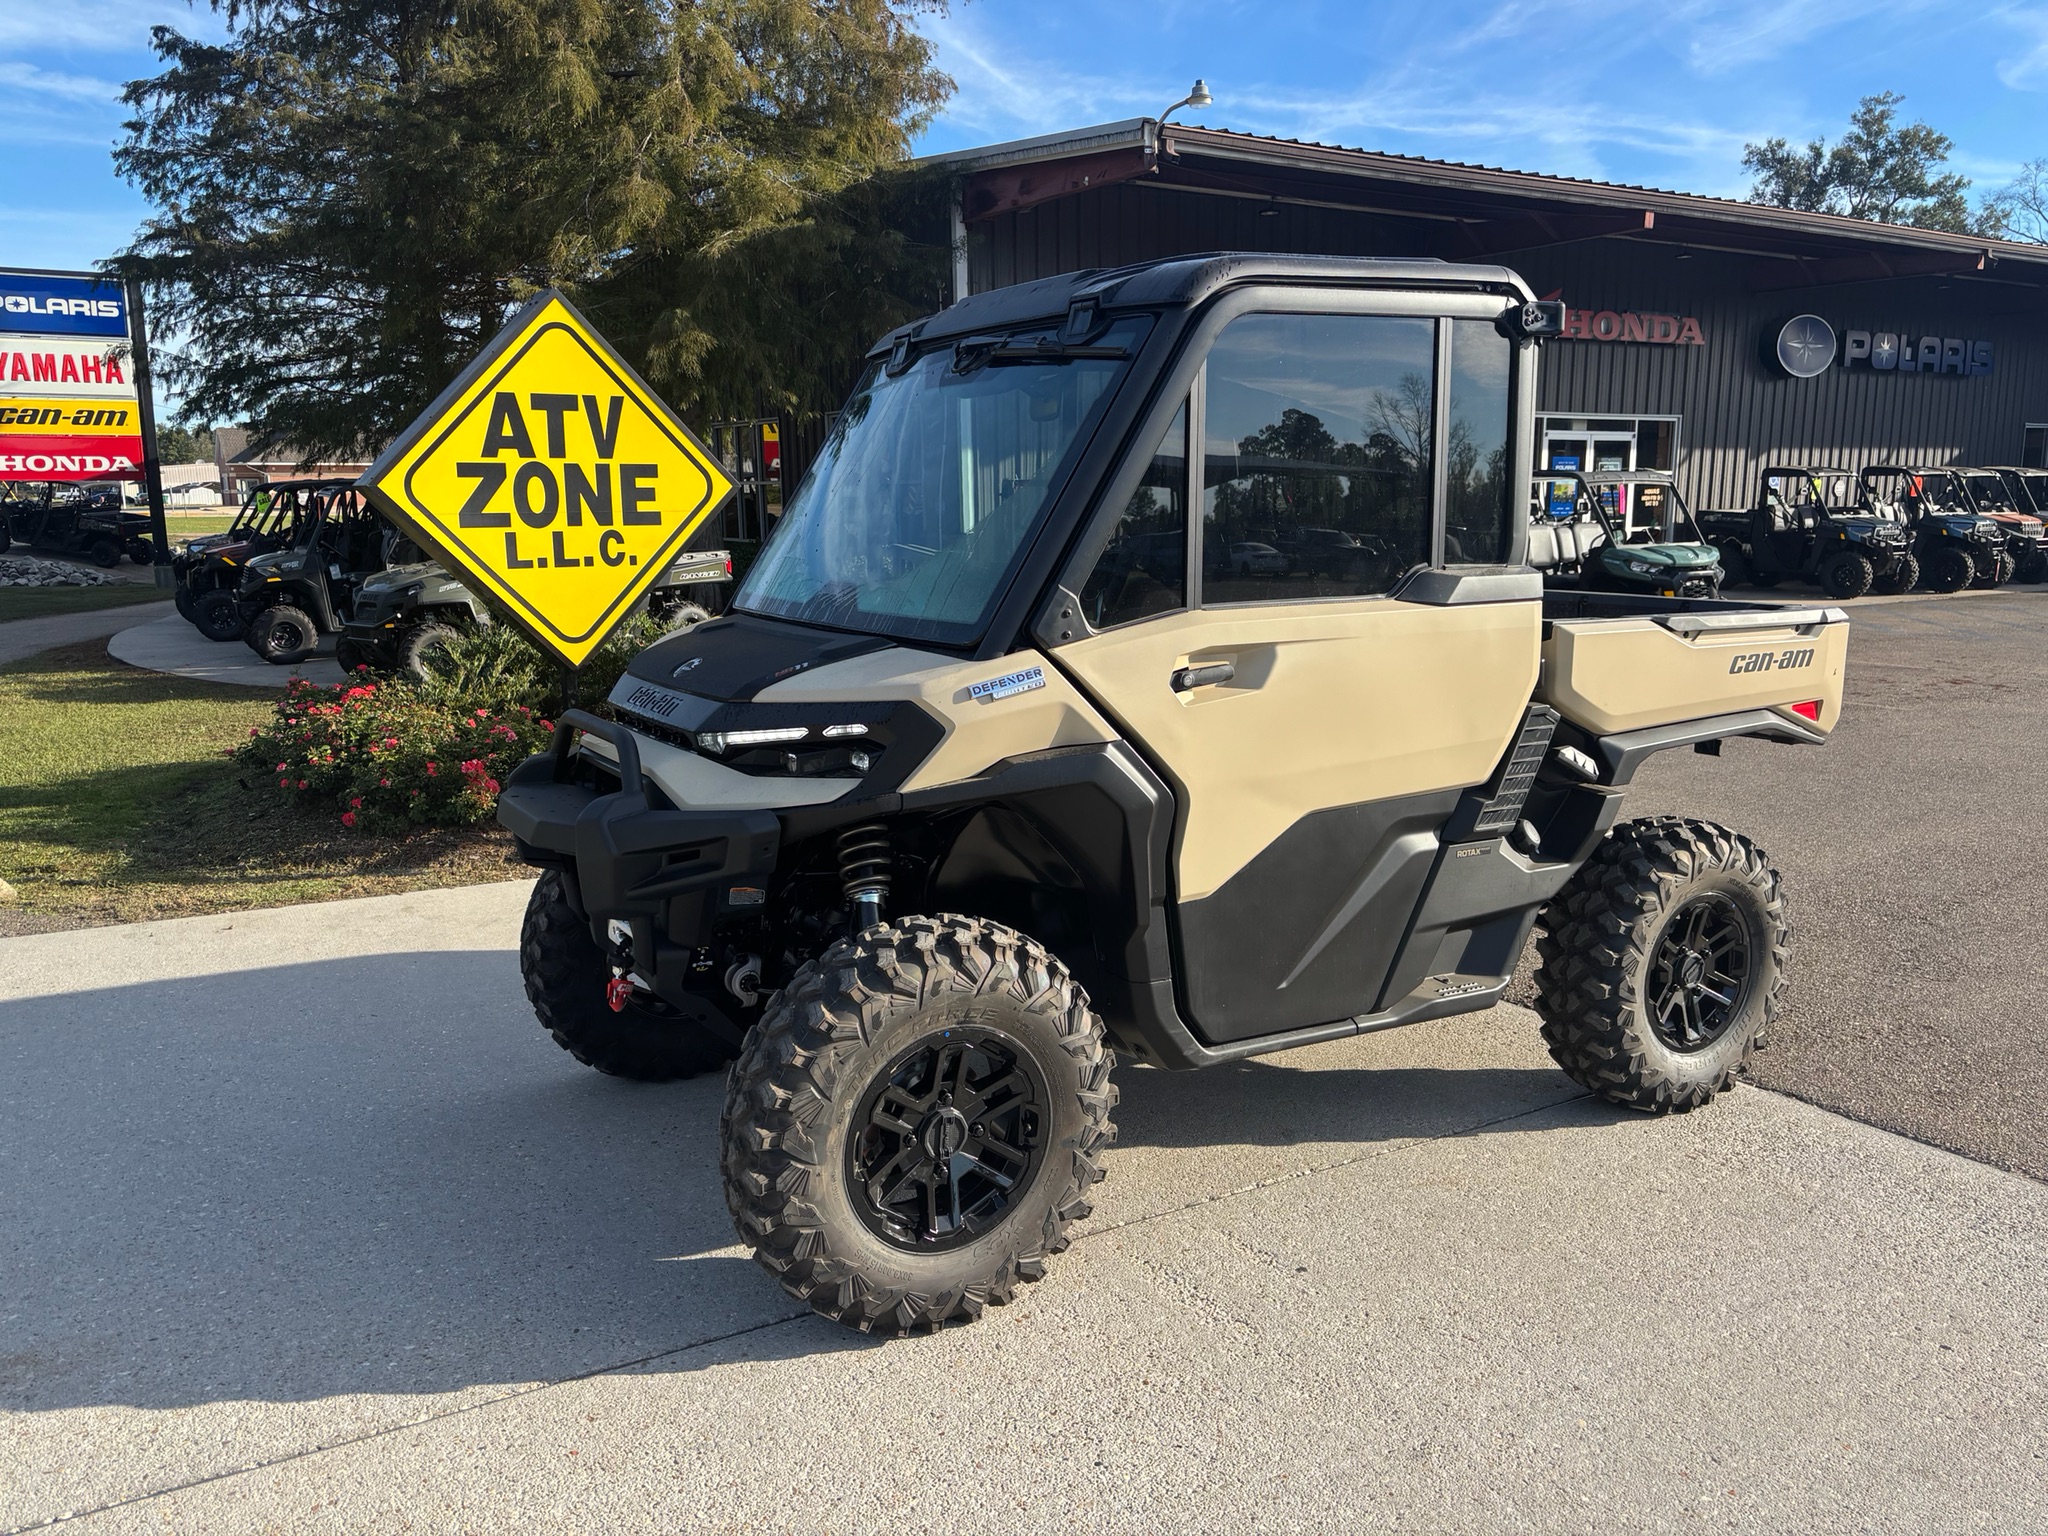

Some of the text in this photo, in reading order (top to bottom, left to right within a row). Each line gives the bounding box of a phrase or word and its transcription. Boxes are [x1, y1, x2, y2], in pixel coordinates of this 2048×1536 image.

[1558, 309, 1705, 345] HONDA
[1844, 330, 1994, 376] POLARIS
[0, 407, 128, 427] can-am
[481, 391, 624, 459] ATV
[0, 455, 139, 472] HONDA
[456, 461, 662, 528] ZONE
[504, 530, 637, 569] L.L.C.
[1729, 648, 1815, 674] can-am
[972, 668, 1042, 695] DEFENDER
[1457, 848, 1481, 858] ROTAX
